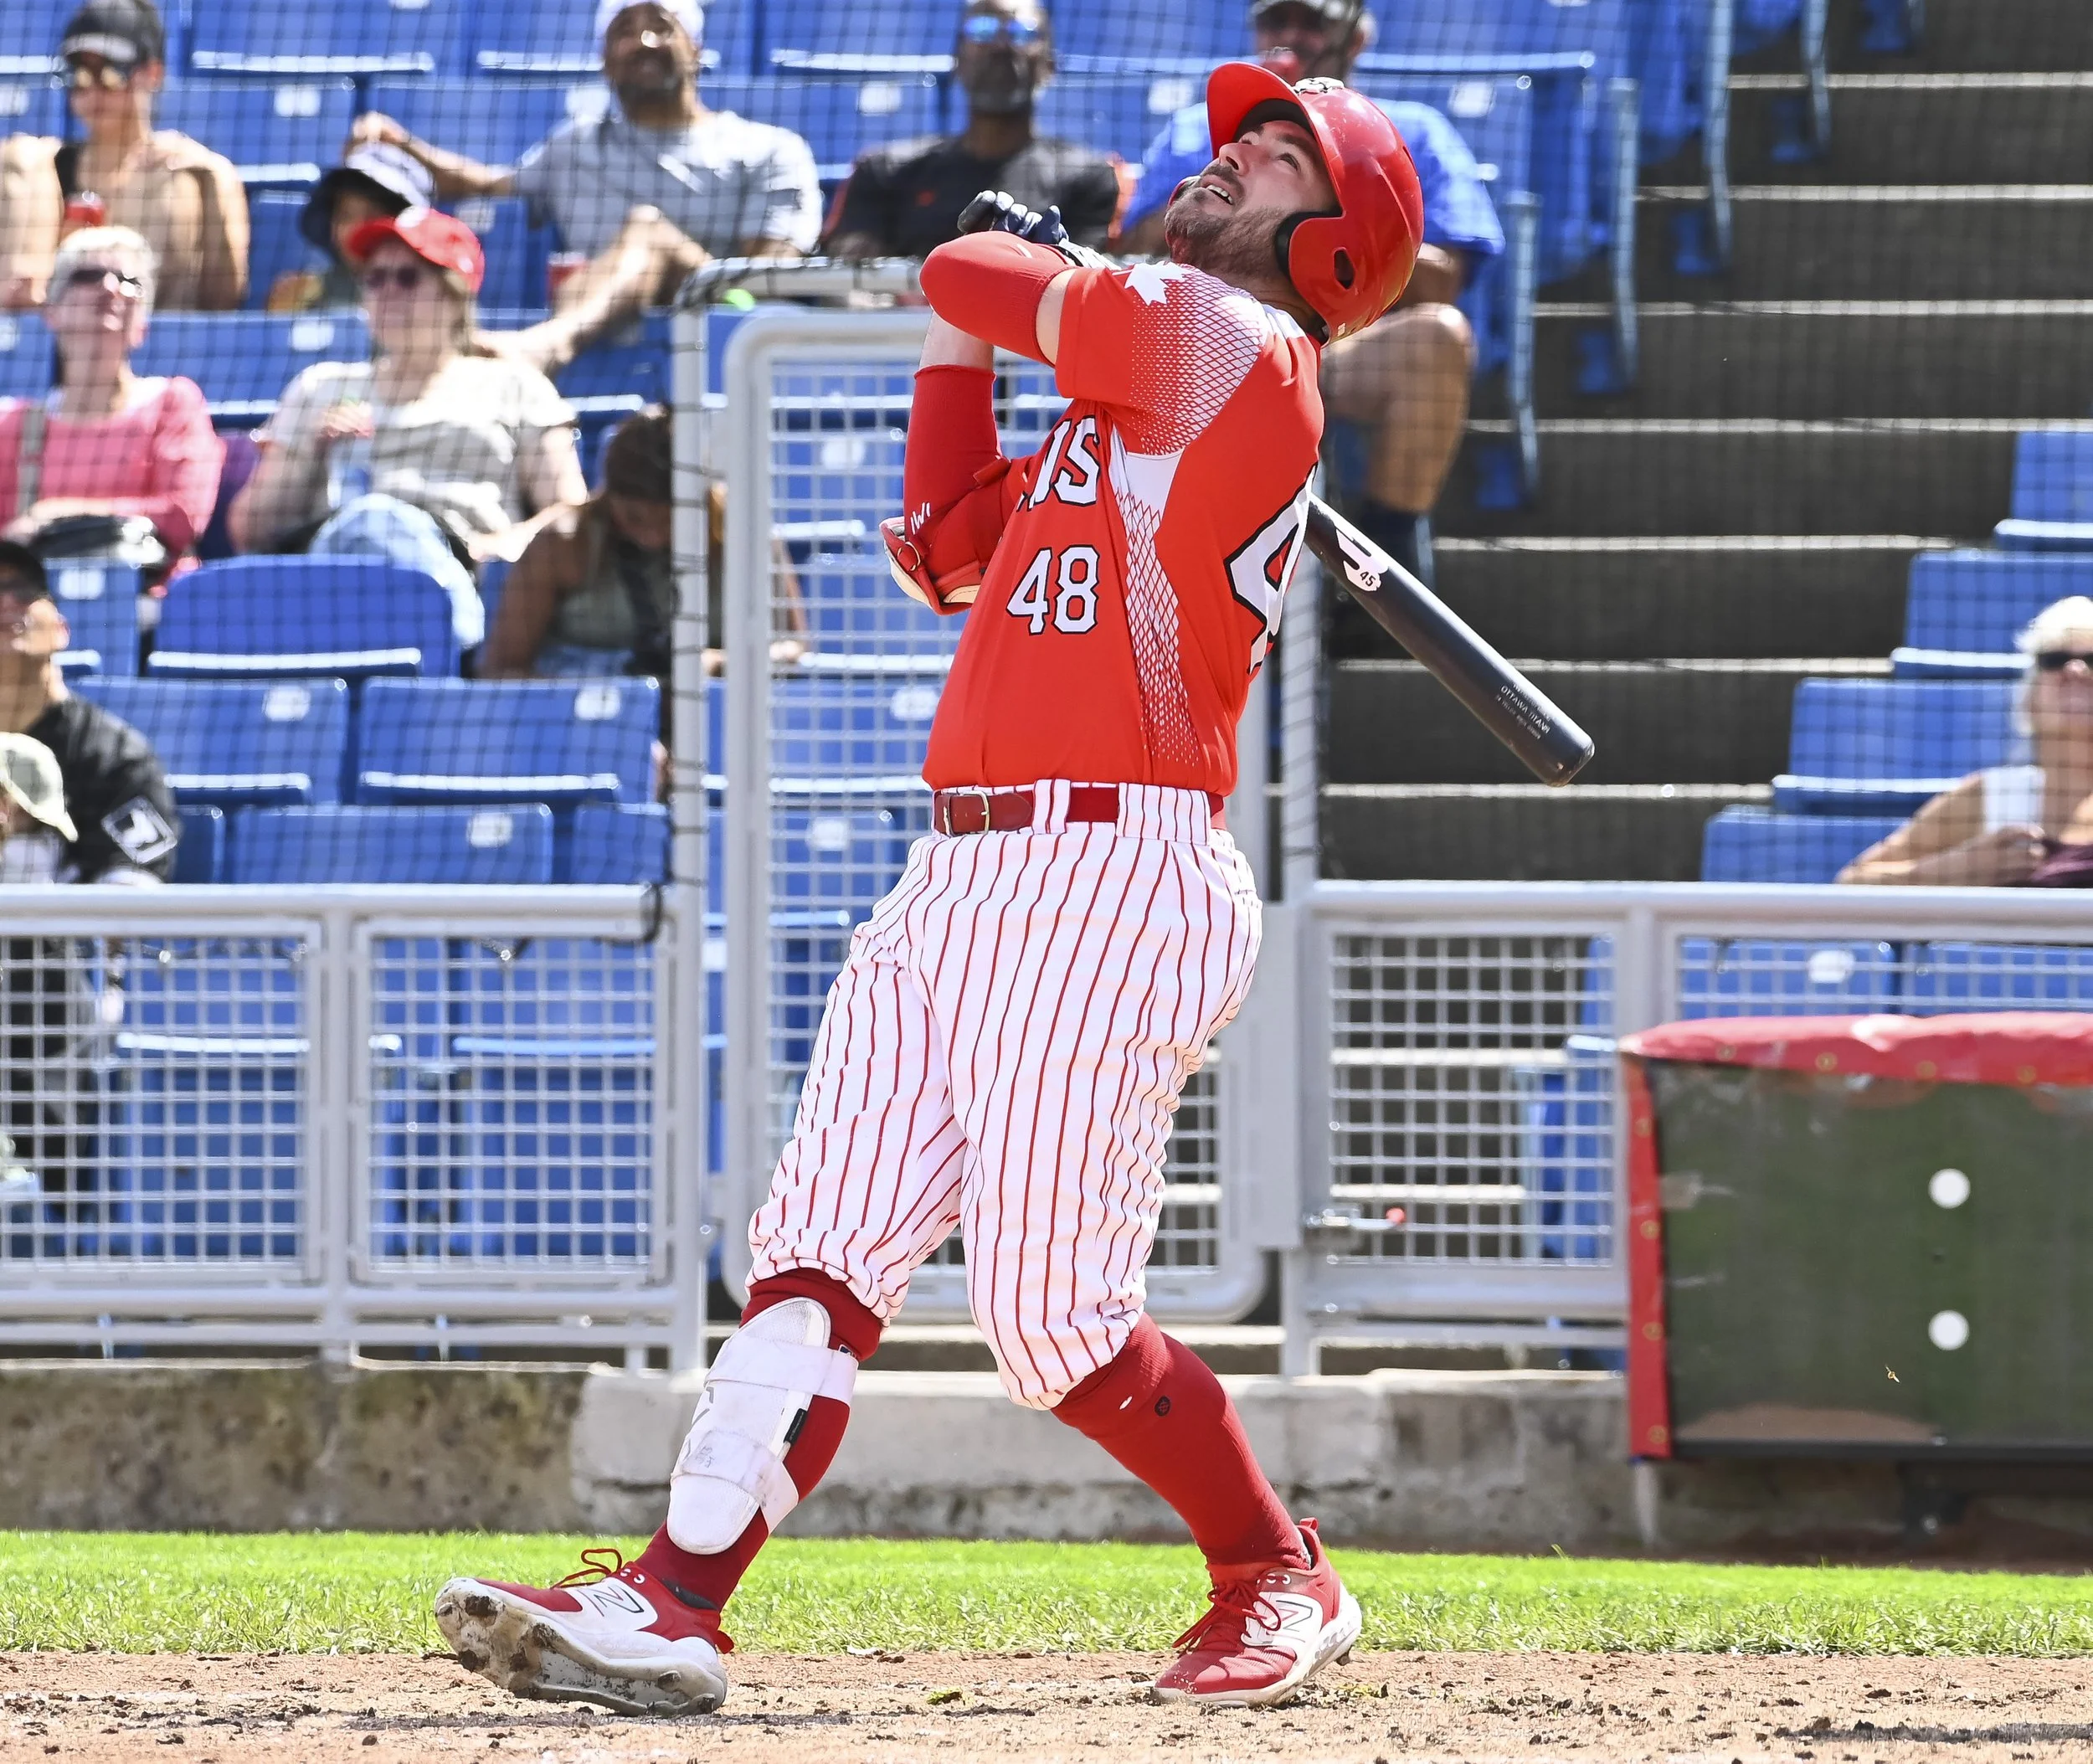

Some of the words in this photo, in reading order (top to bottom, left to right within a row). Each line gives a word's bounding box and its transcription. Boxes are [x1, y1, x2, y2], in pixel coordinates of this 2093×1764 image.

[1005, 544, 1100, 636] 48
[1360, 571, 1376, 587] 45
[1500, 685, 1529, 714] OTTAWA
